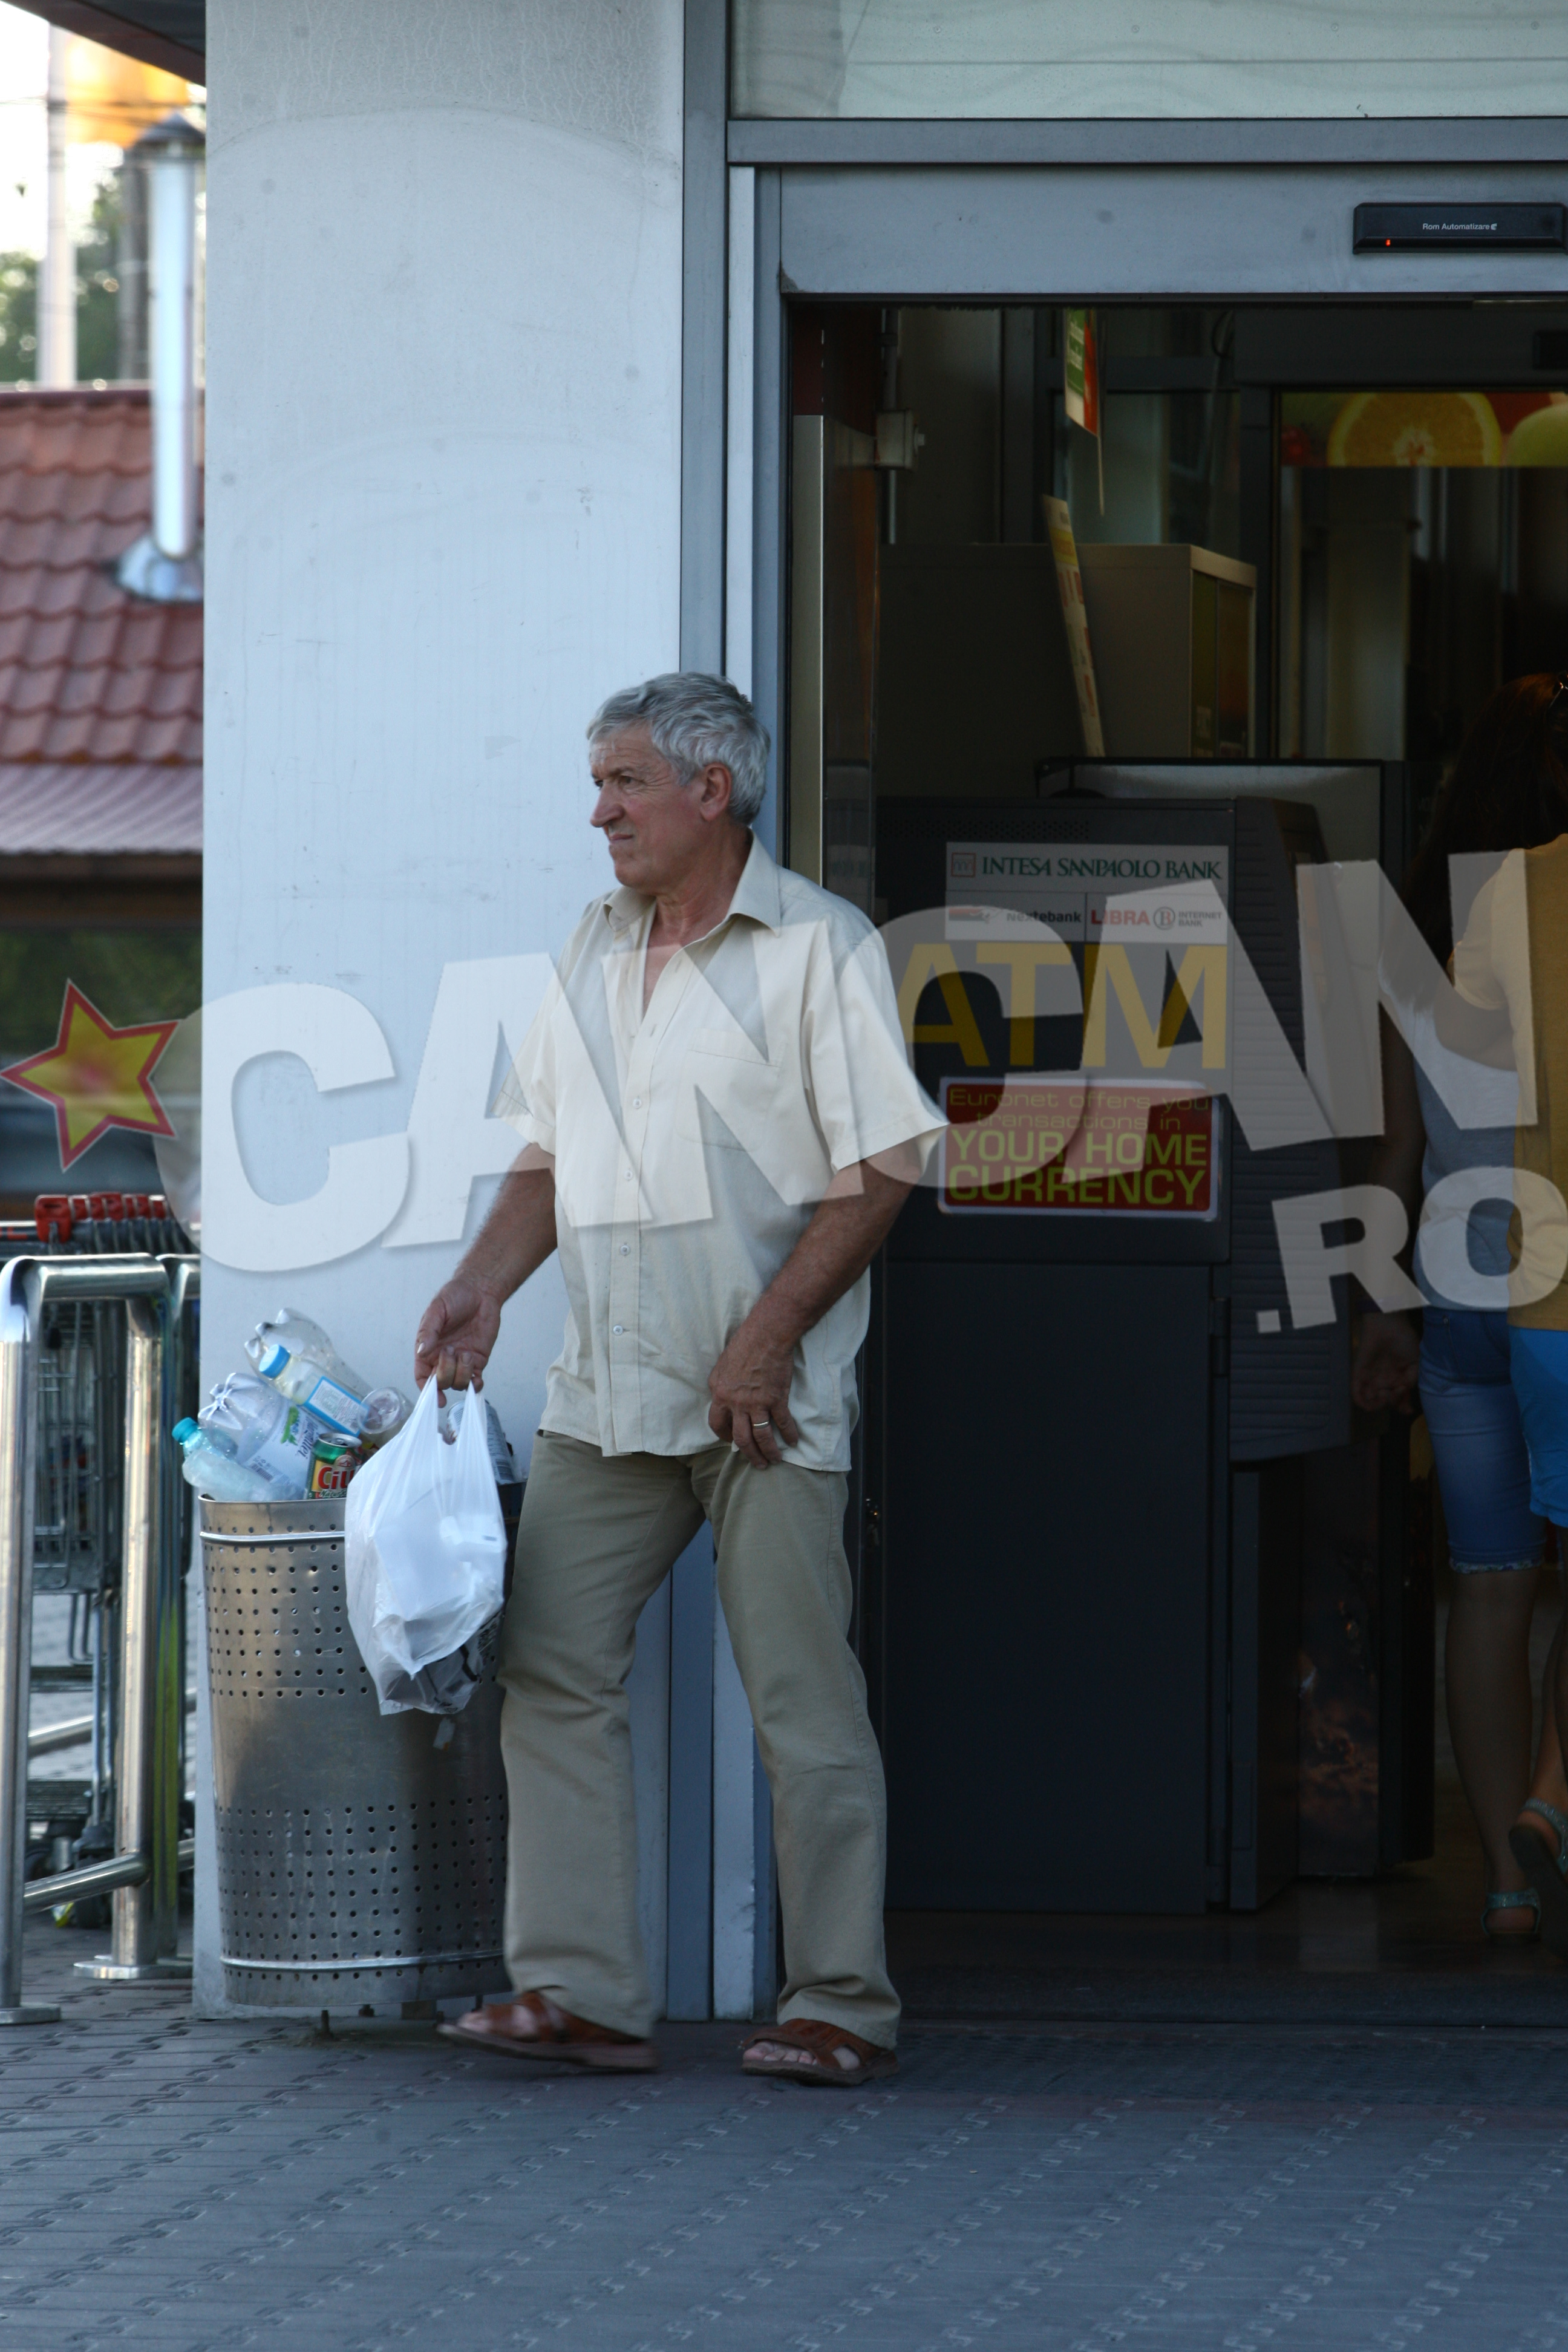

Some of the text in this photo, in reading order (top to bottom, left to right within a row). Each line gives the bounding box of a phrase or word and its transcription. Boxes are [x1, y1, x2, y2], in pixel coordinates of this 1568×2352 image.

[982, 857, 1222, 879] INTESA SANPAOLO BANK
[1006, 911, 1082, 923] Nextebank
[1091, 909, 1151, 926] LIBRA
[1179, 911, 1222, 920] INTERNET
[897, 942, 1227, 1070] ATM
[950, 1089, 1209, 1112] Euronet offers you
[977, 1111, 1180, 1130] transactions in
[951, 1129, 1207, 1166] YOUR HOME
[949, 1165, 1206, 1205] CURRENCY
